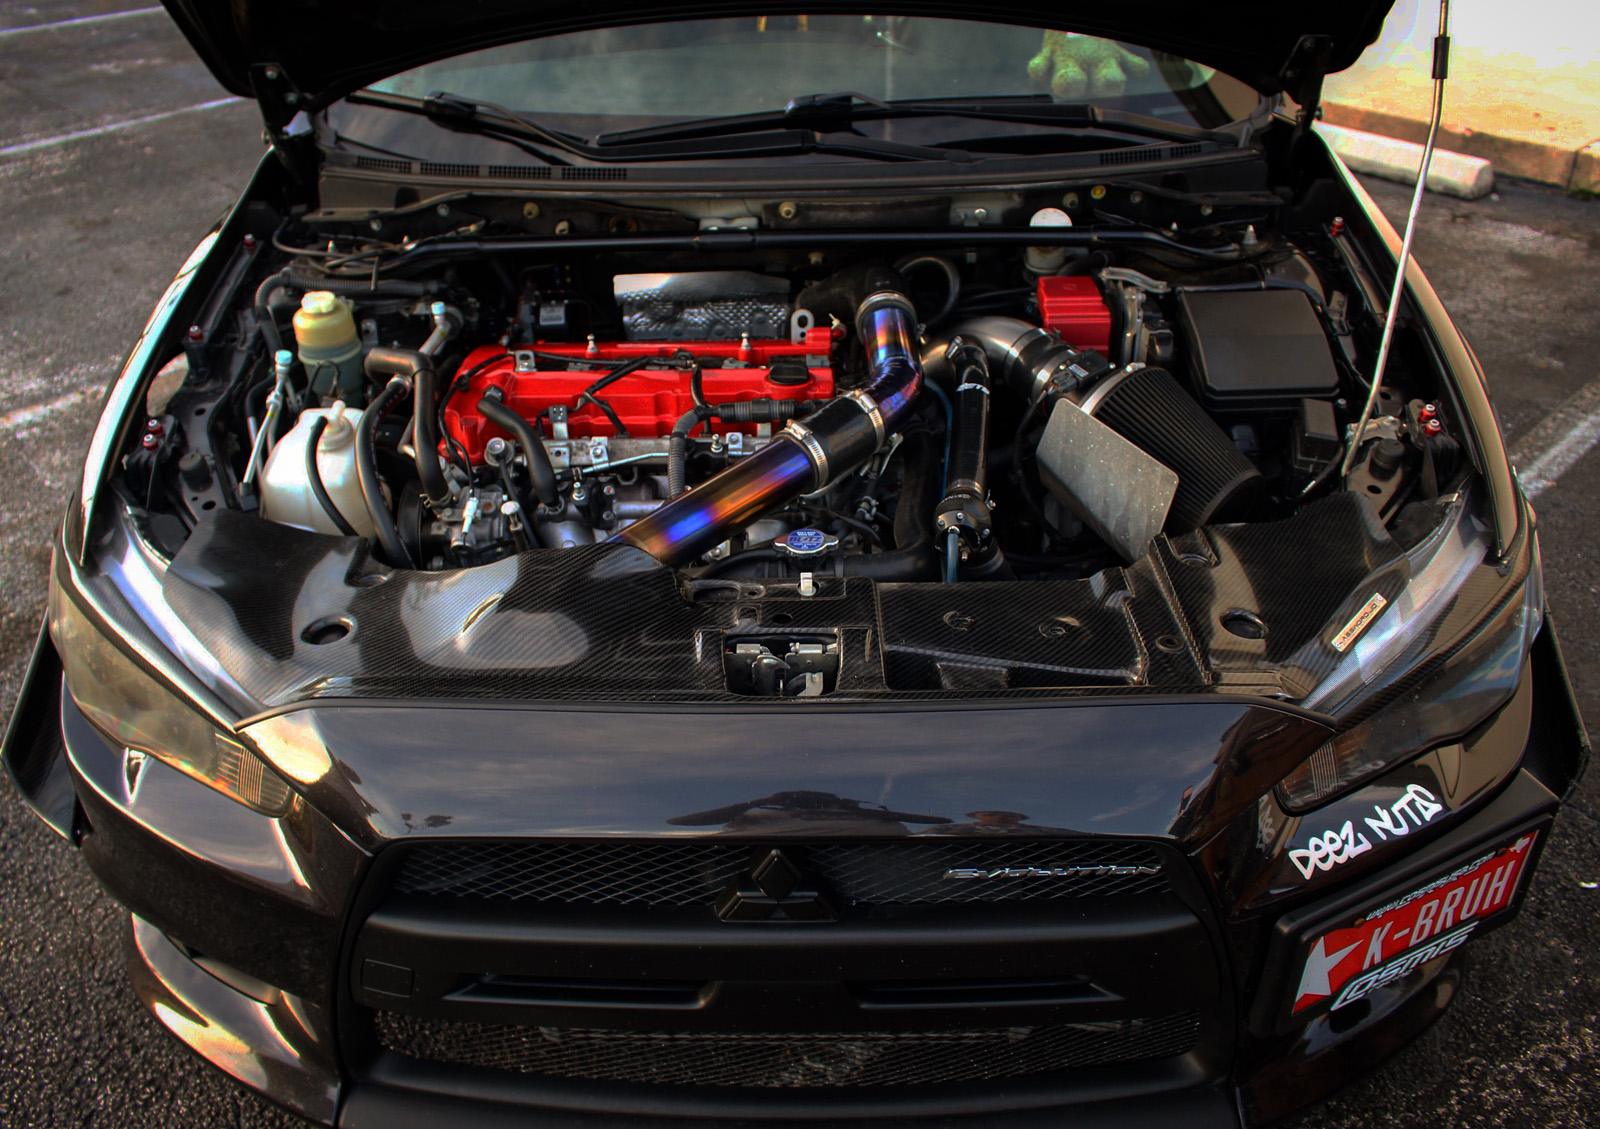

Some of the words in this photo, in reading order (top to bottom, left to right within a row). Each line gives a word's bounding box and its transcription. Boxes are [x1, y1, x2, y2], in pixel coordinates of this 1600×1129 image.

[943, 865, 1162, 879] EVOLUTION
[1362, 860, 1516, 971] K-BRUH
[1330, 921, 1479, 1011] COSMIS
